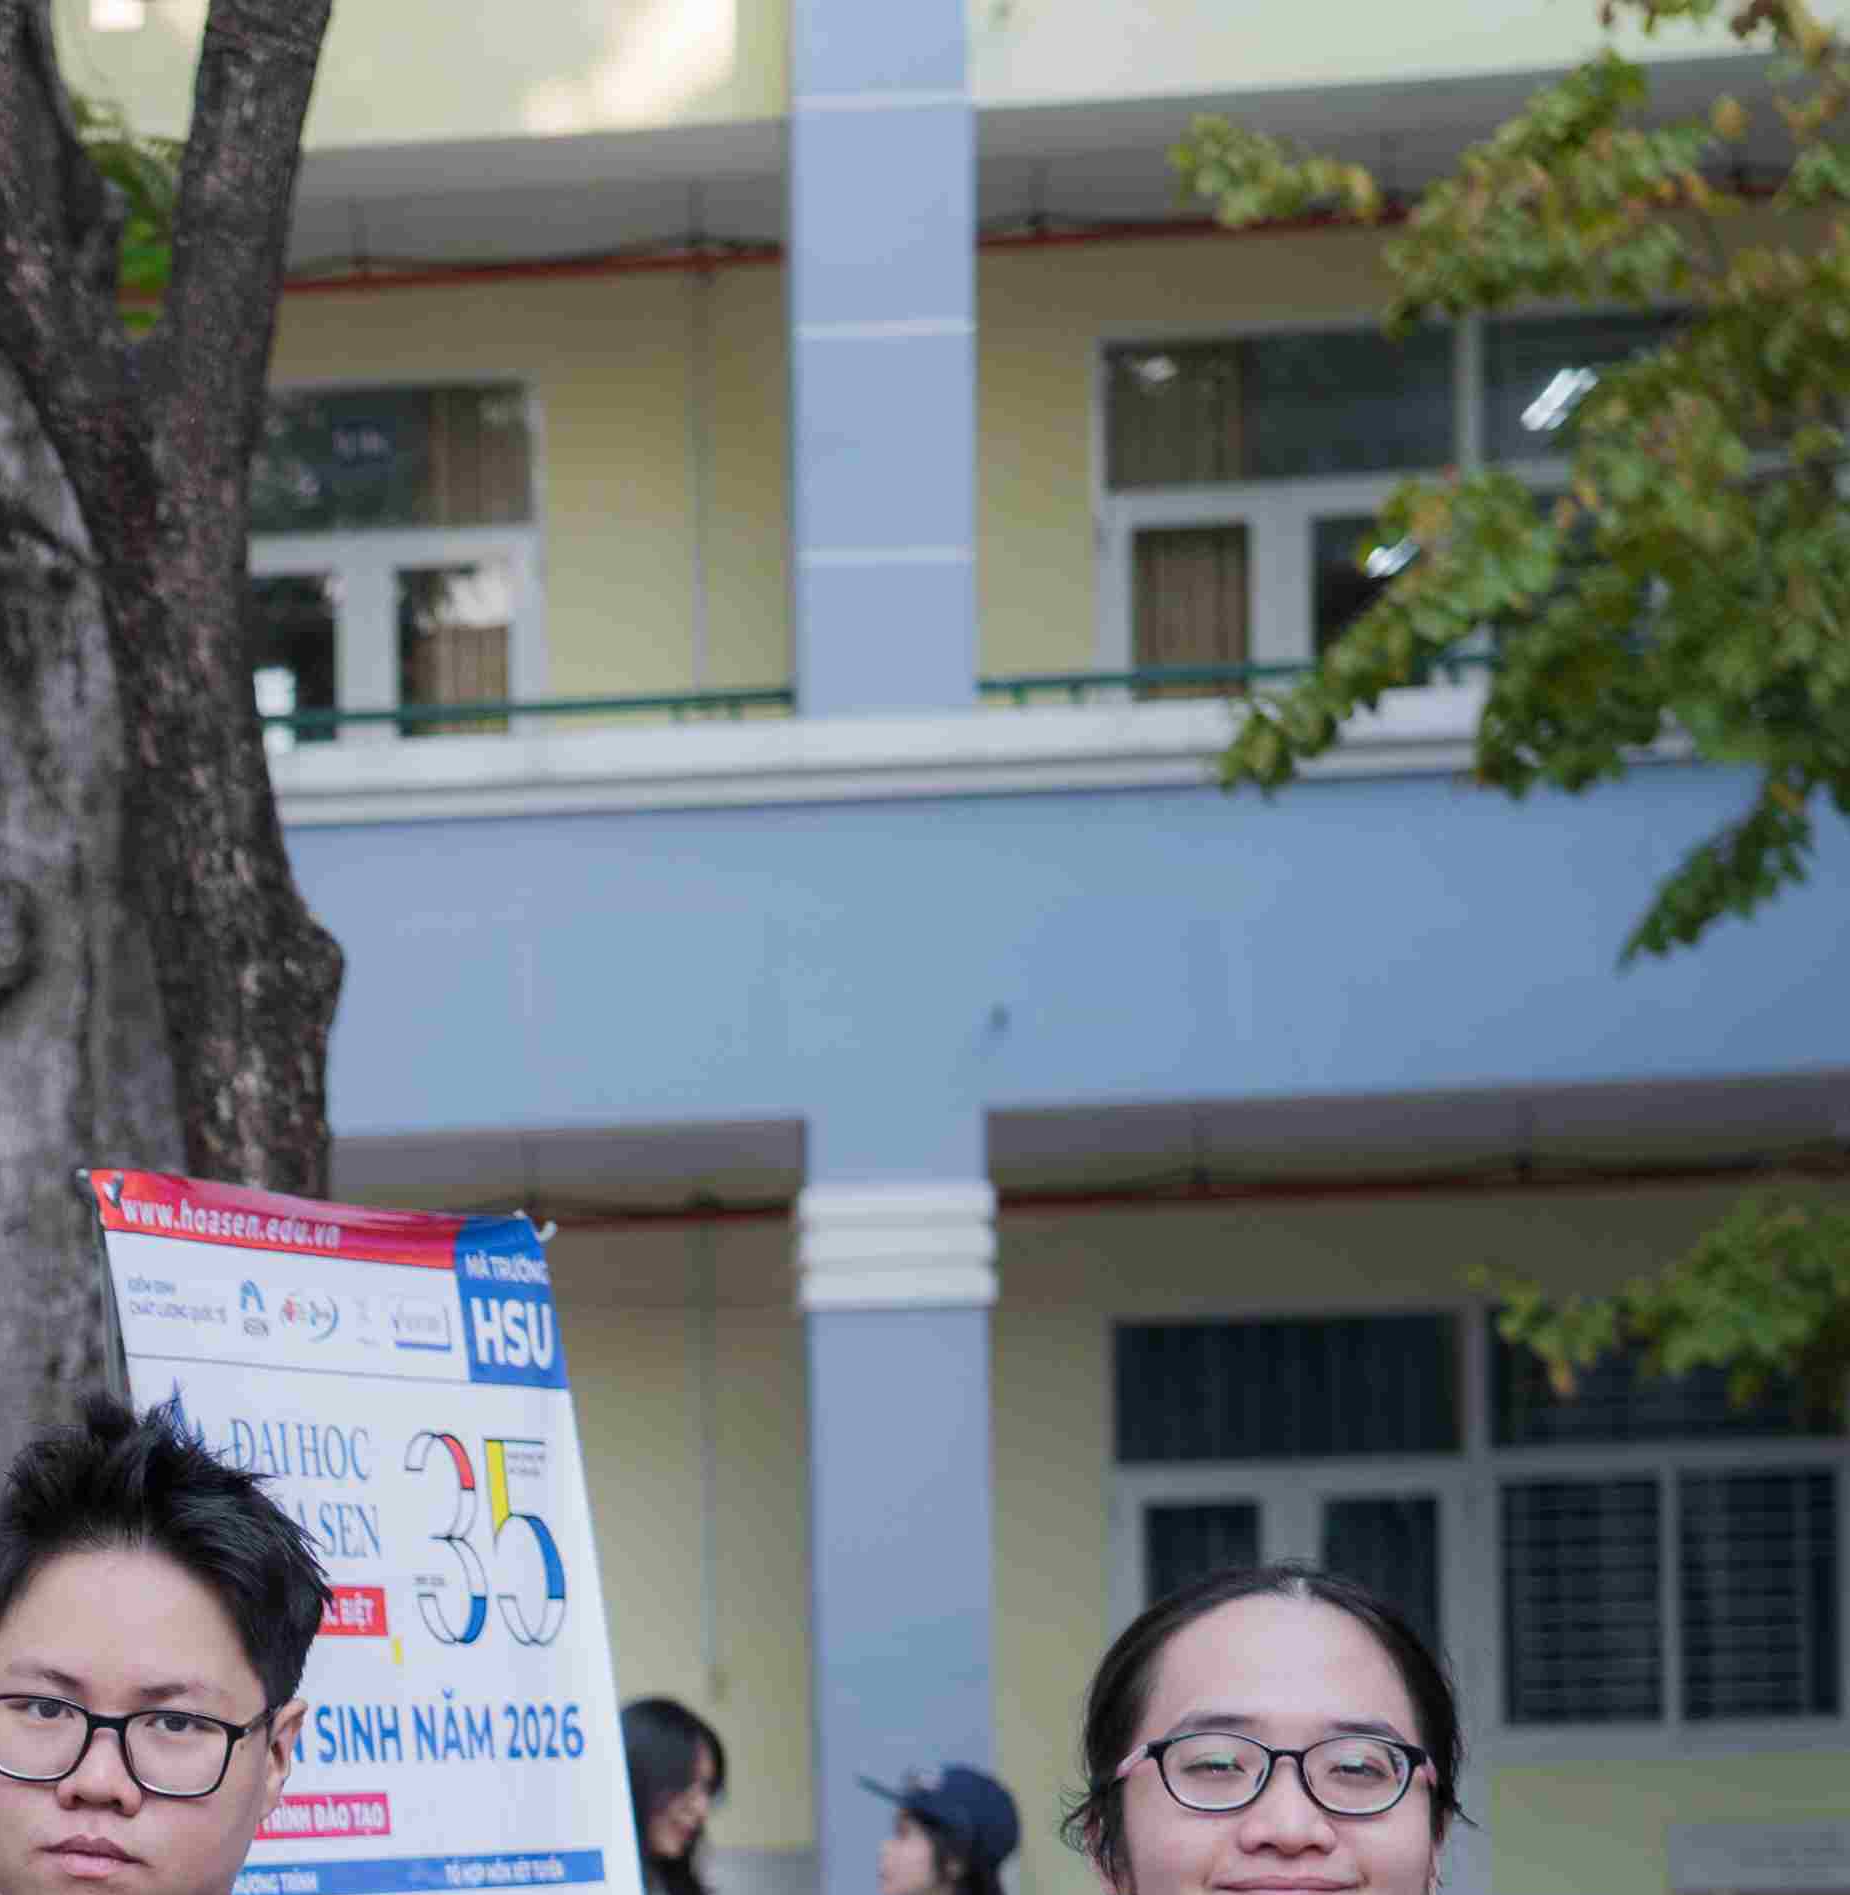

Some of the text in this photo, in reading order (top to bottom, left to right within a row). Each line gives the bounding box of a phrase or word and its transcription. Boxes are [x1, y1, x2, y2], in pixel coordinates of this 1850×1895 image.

[121, 1199, 341, 1249] www.hoasen.edu.vn
[469, 1296, 553, 1370] HSU
[318, 1501, 383, 1560] SEN
[314, 1703, 403, 1764] SINH
[411, 1686, 496, 1763] NĂM
[503, 1703, 586, 1762] 2026
